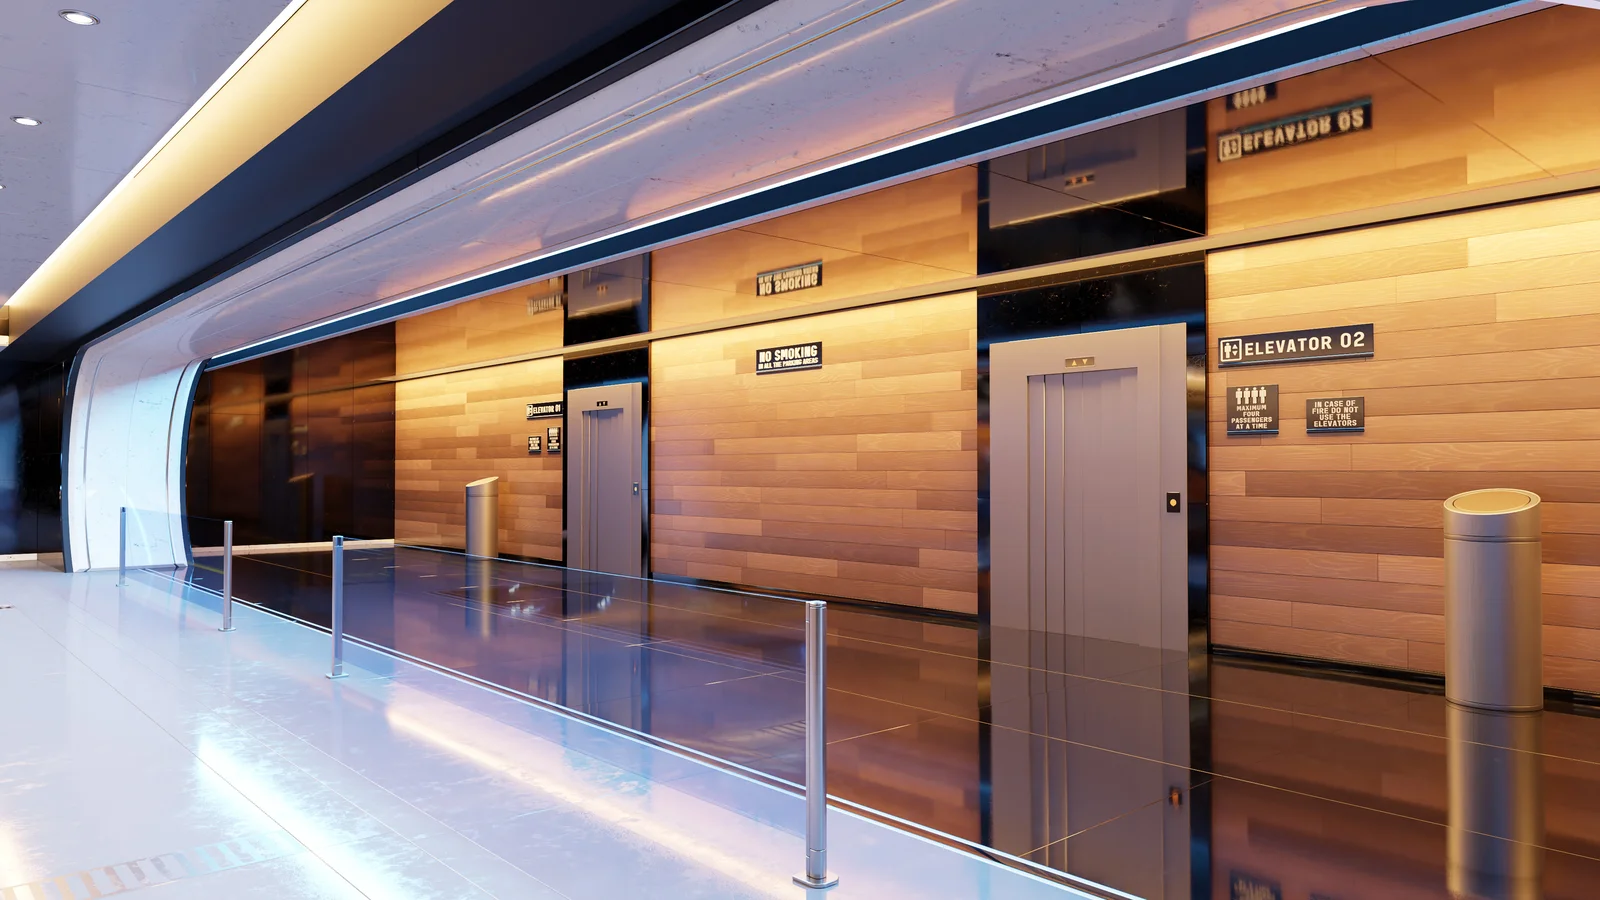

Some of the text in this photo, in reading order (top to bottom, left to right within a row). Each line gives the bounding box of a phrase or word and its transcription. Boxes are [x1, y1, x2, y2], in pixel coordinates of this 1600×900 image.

[1244, 331, 1365, 356] ELEVATOR 02
[759, 345, 818, 363] NO SMOKING
[1324, 400, 1344, 408] CASE
[1345, 399, 1356, 407] OF
[1231, 416, 1273, 424] PASSENGERS
[1319, 413, 1334, 421] USE
[1313, 419, 1357, 427] ELEVATORS
